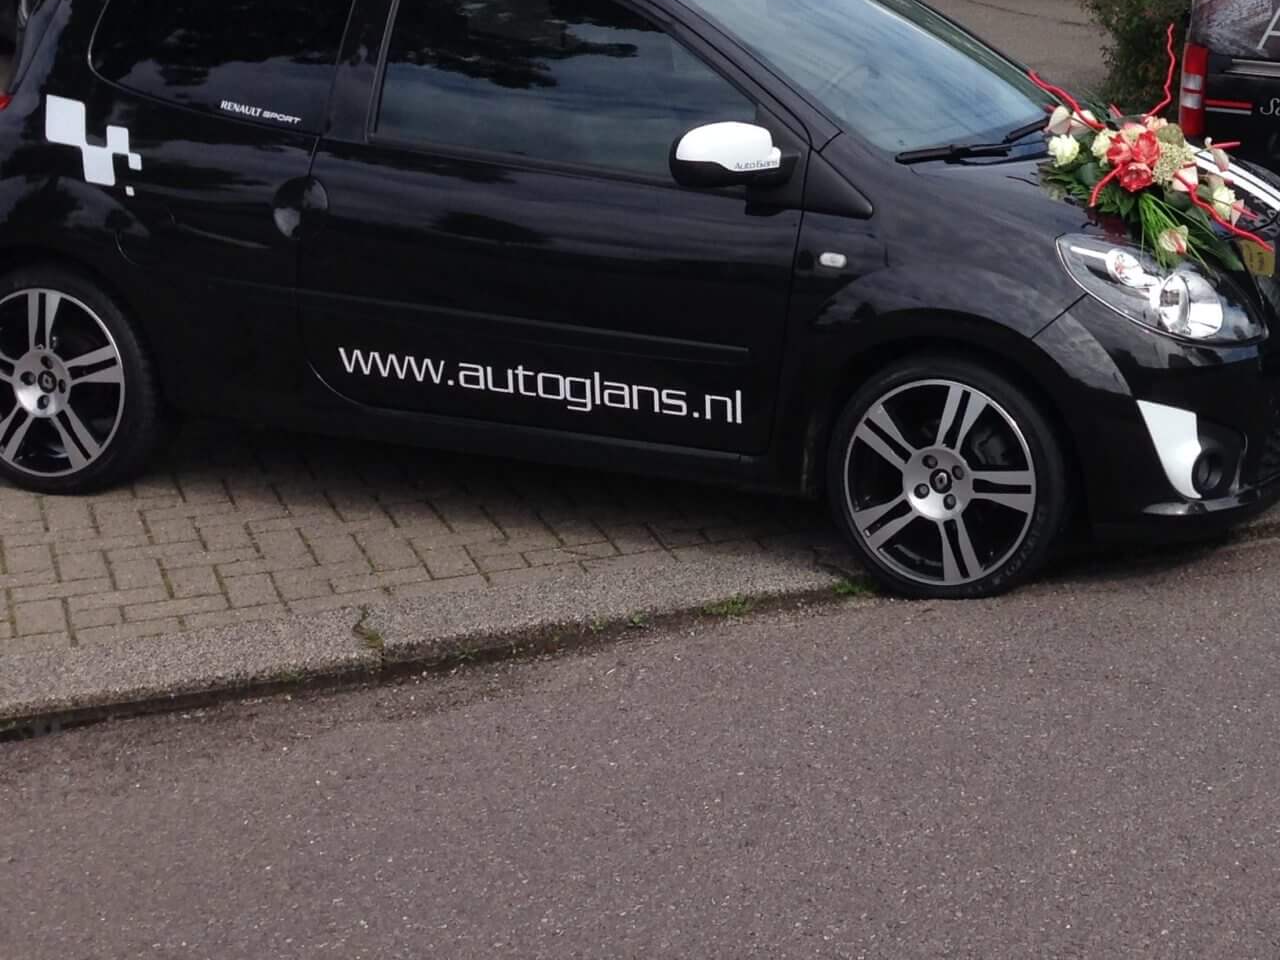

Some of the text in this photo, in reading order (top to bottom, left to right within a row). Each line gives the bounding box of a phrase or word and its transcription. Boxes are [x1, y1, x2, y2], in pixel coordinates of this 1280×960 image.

[220, 100, 301, 124] RENAULT SPORT
[338, 347, 742, 424] www.autoglans.nl
